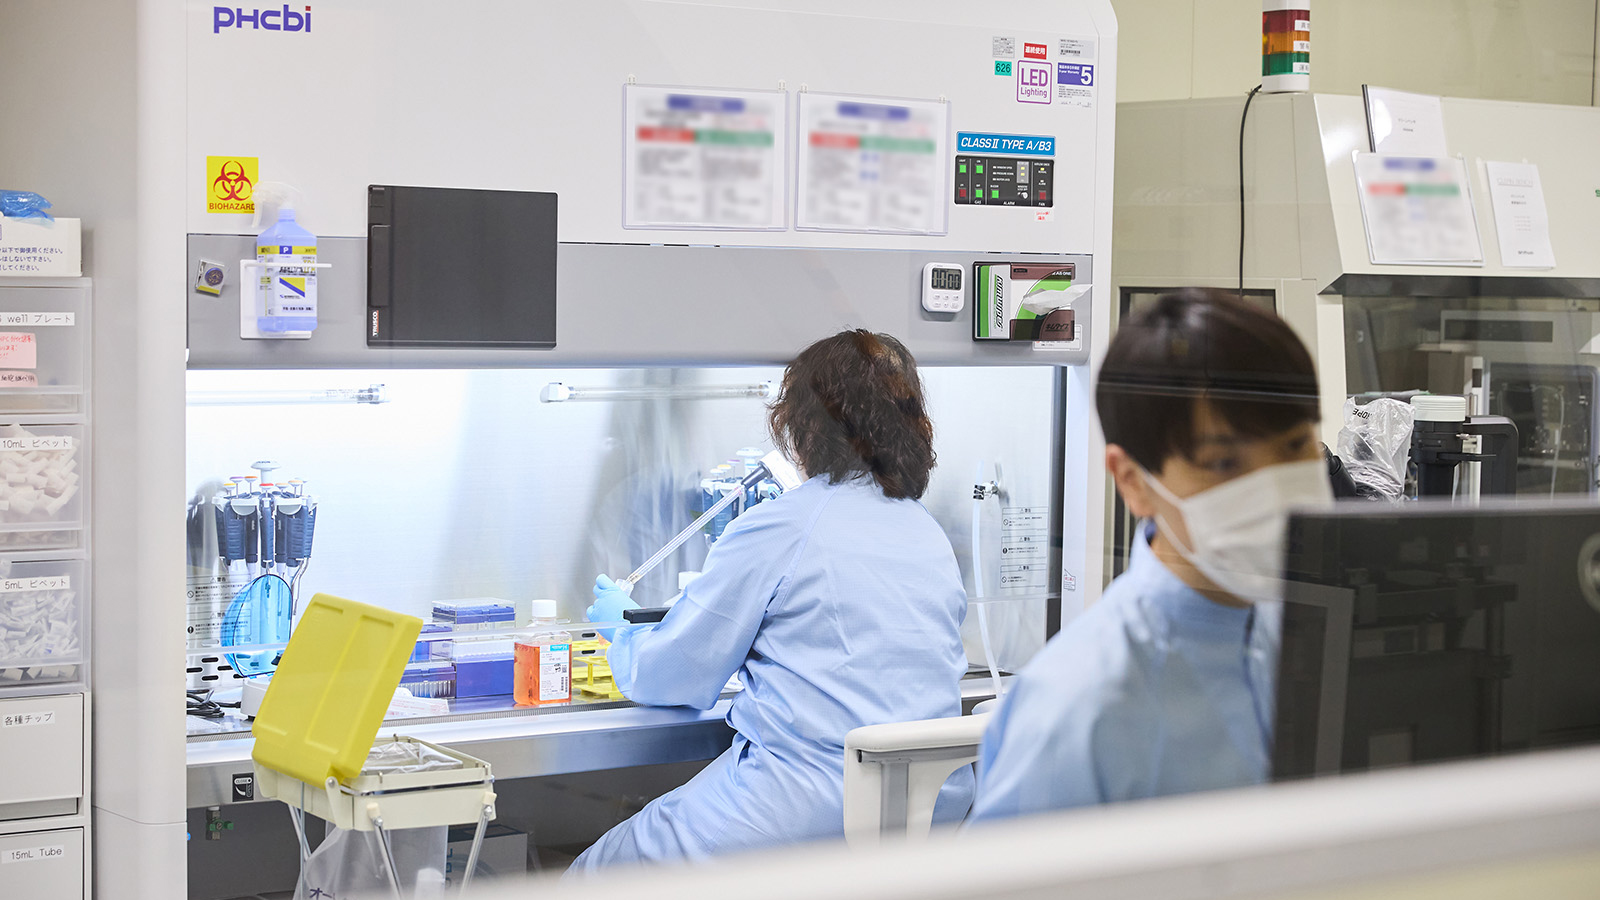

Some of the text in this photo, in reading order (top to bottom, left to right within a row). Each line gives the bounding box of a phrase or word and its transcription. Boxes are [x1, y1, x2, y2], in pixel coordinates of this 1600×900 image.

[995, 63, 1011, 73] 626
[1021, 68, 1048, 86] LED
[1080, 66, 1092, 85] 5
[1020, 87, 1047, 98] Lighting
[1002, 139, 1025, 149] TYPE
[1026, 141, 1052, 151] A/B3
[7, 314, 70, 323] well プレート
[3, 438, 69, 448] 10mL ピペット
[5, 578, 66, 590] 5mL ピペット
[4, 713, 53, 726] 各種チップ
[12, 848, 62, 860] 15mL Tube
